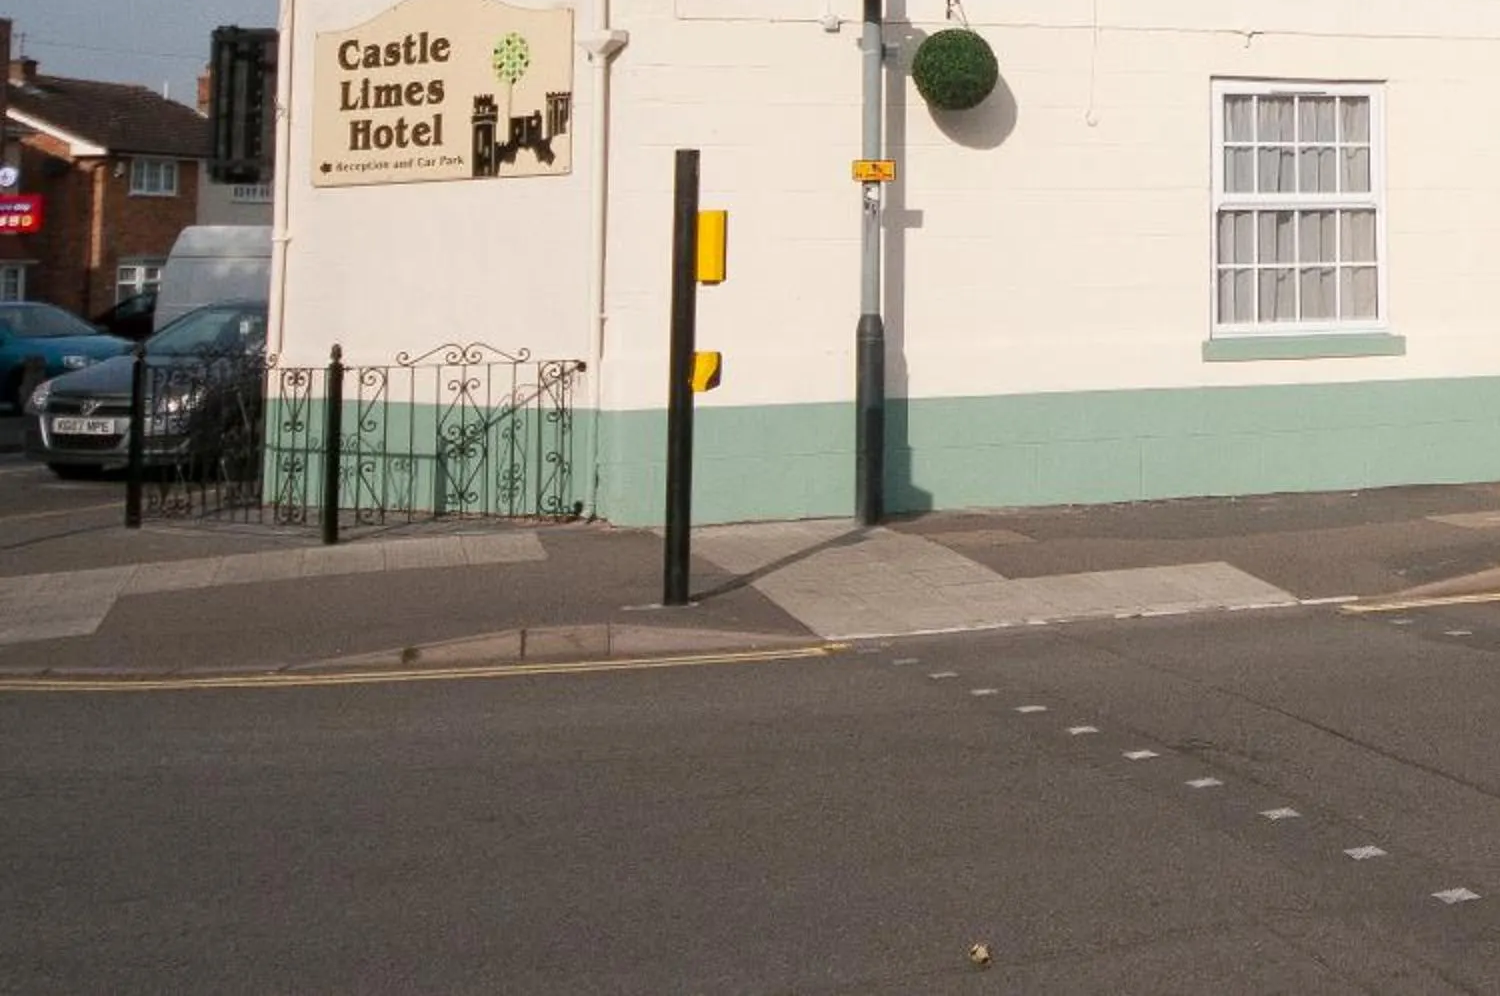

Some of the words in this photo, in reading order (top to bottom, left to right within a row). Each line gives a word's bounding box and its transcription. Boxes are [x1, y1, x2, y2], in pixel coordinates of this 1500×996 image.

[337, 31, 451, 71] Castle
[339, 78, 445, 111] Limes
[349, 113, 443, 151] Hotel
[335, 161, 389, 173] Reception
[394, 158, 413, 169] and
[417, 157, 436, 168] Car
[439, 154, 464, 167] Park
